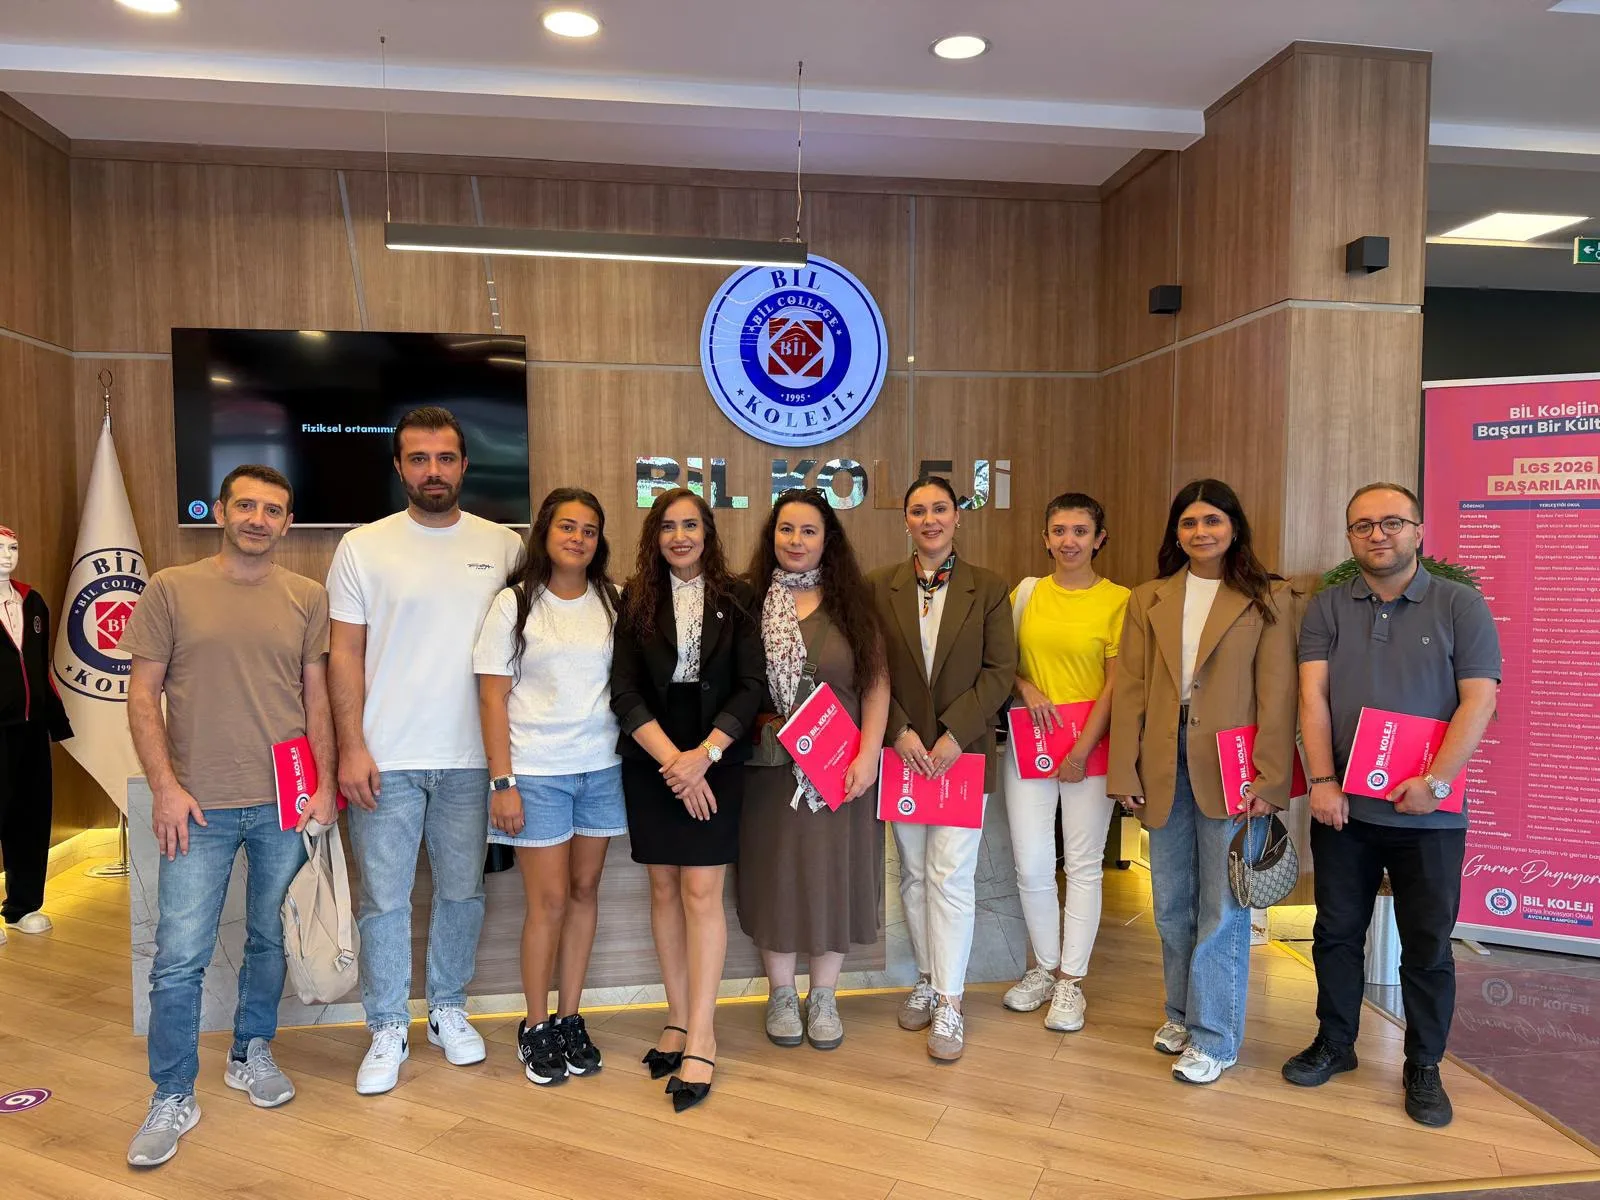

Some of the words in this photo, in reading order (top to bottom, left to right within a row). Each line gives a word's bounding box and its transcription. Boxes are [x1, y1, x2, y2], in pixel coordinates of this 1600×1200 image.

[777, 295, 839, 328] COLLEGE
[785, 393, 806, 403] 1995
[744, 393, 847, 429] KOLEJİ
[1509, 404, 1534, 419] BİL
[1538, 400, 1600, 418] Kolejin
[302, 423, 342, 433] Fiziksel
[1477, 424, 1533, 439] Başarı
[1537, 420, 1563, 433] Bir
[1520, 463, 1549, 474] LGS
[1553, 461, 1593, 473] 2026
[91, 551, 142, 576] BİL
[77, 588, 98, 608] BİL
[101, 579, 145, 593] COLLE
[107, 615, 127, 632] Bİ
[117, 664, 131, 672] 199
[73, 668, 129, 694] KOL
[1462, 854, 1519, 877] Gurur
[1523, 895, 1544, 907] BİL
[1547, 897, 1594, 913] KOLEJİ
